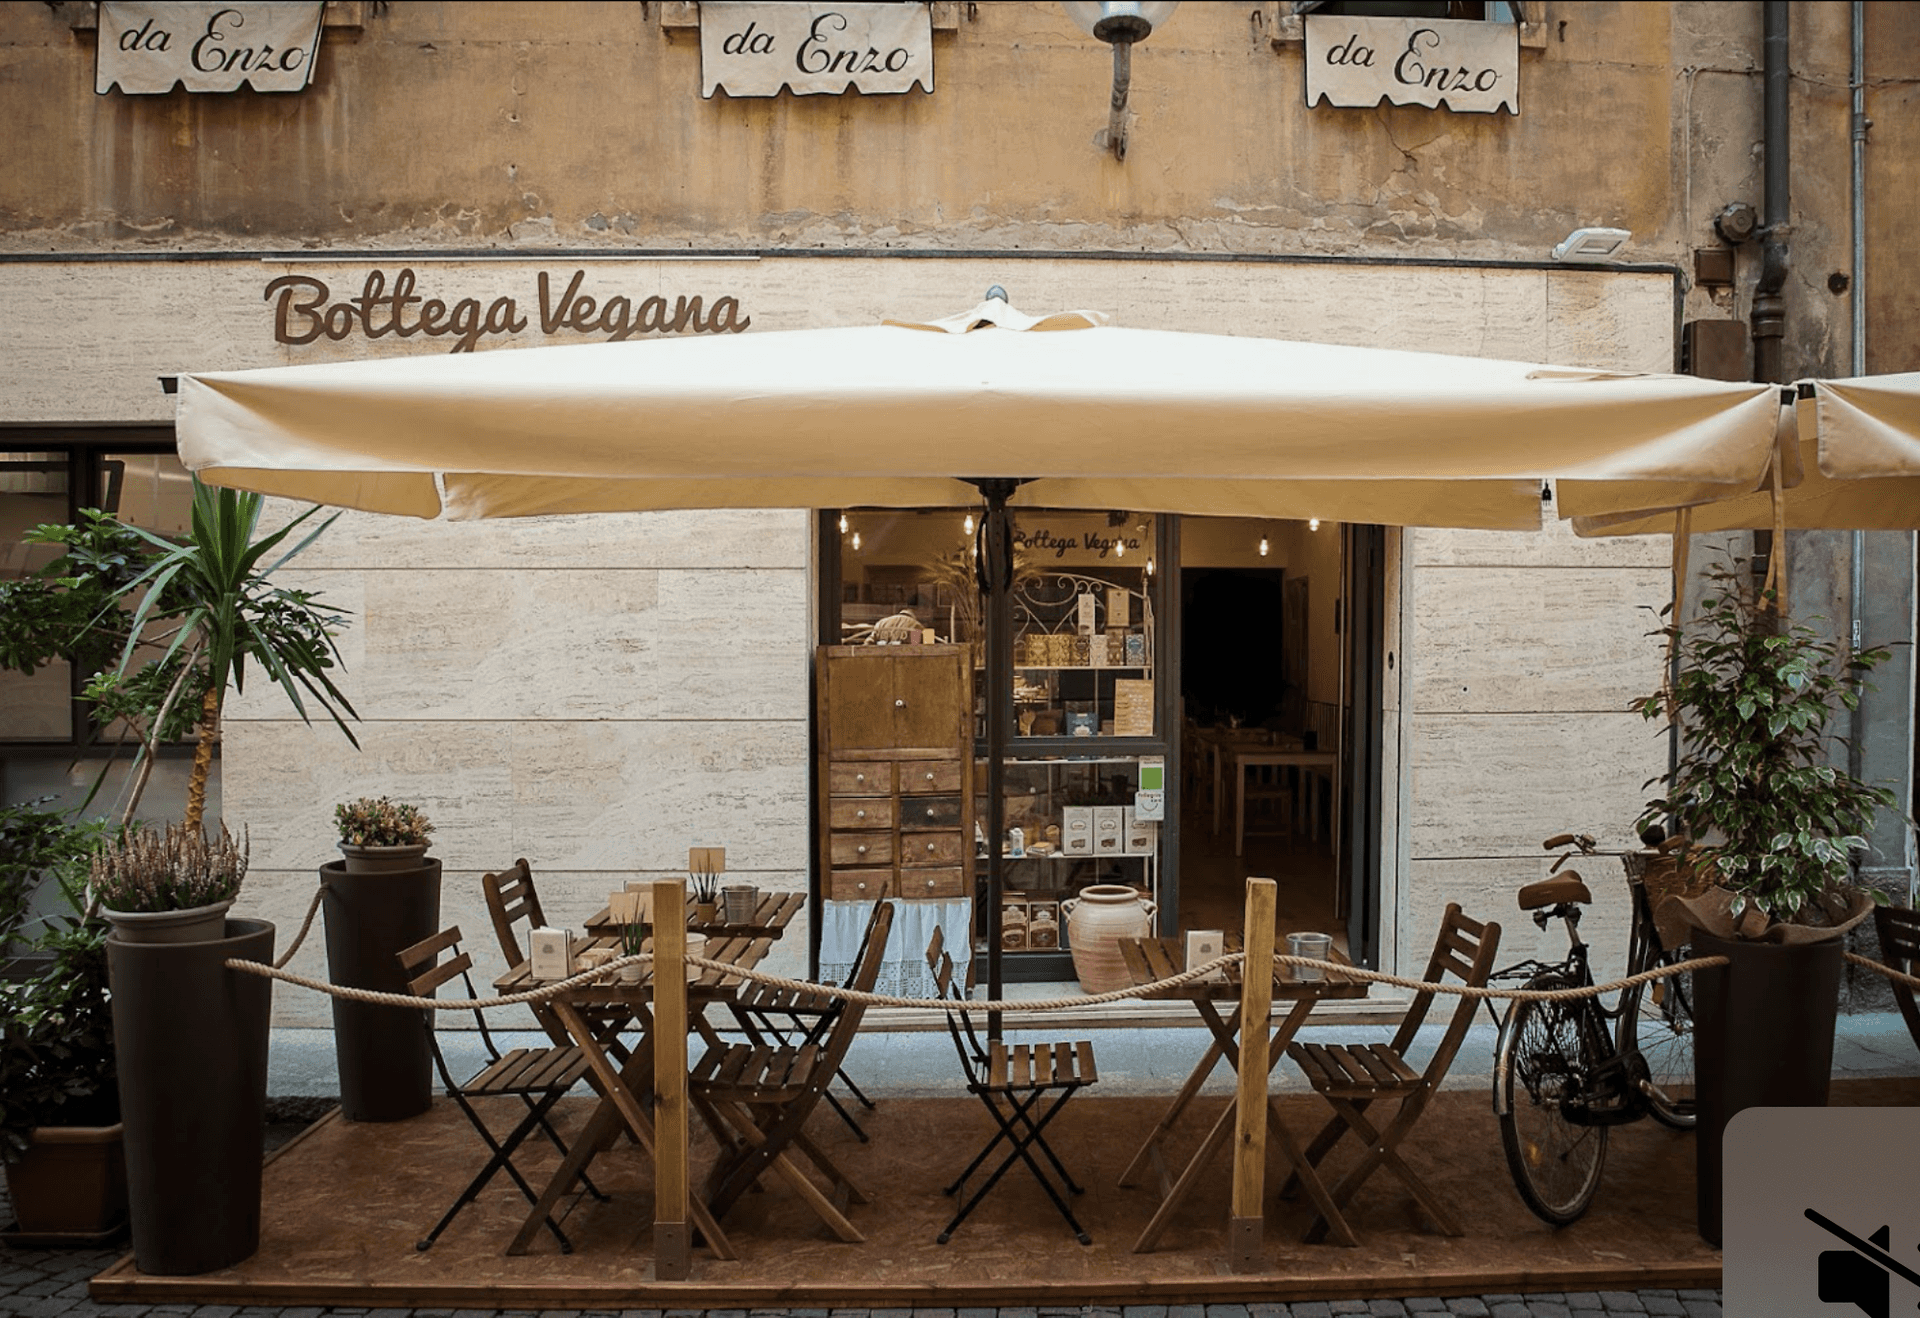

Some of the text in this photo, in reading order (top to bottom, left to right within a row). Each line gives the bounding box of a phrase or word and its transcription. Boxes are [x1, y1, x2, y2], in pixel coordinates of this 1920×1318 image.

[119, 9, 310, 73] da Enzo
[722, 12, 915, 74] da Enzo
[1326, 28, 1503, 92] da Enzo
[263, 267, 751, 353] Bottega Vegana
